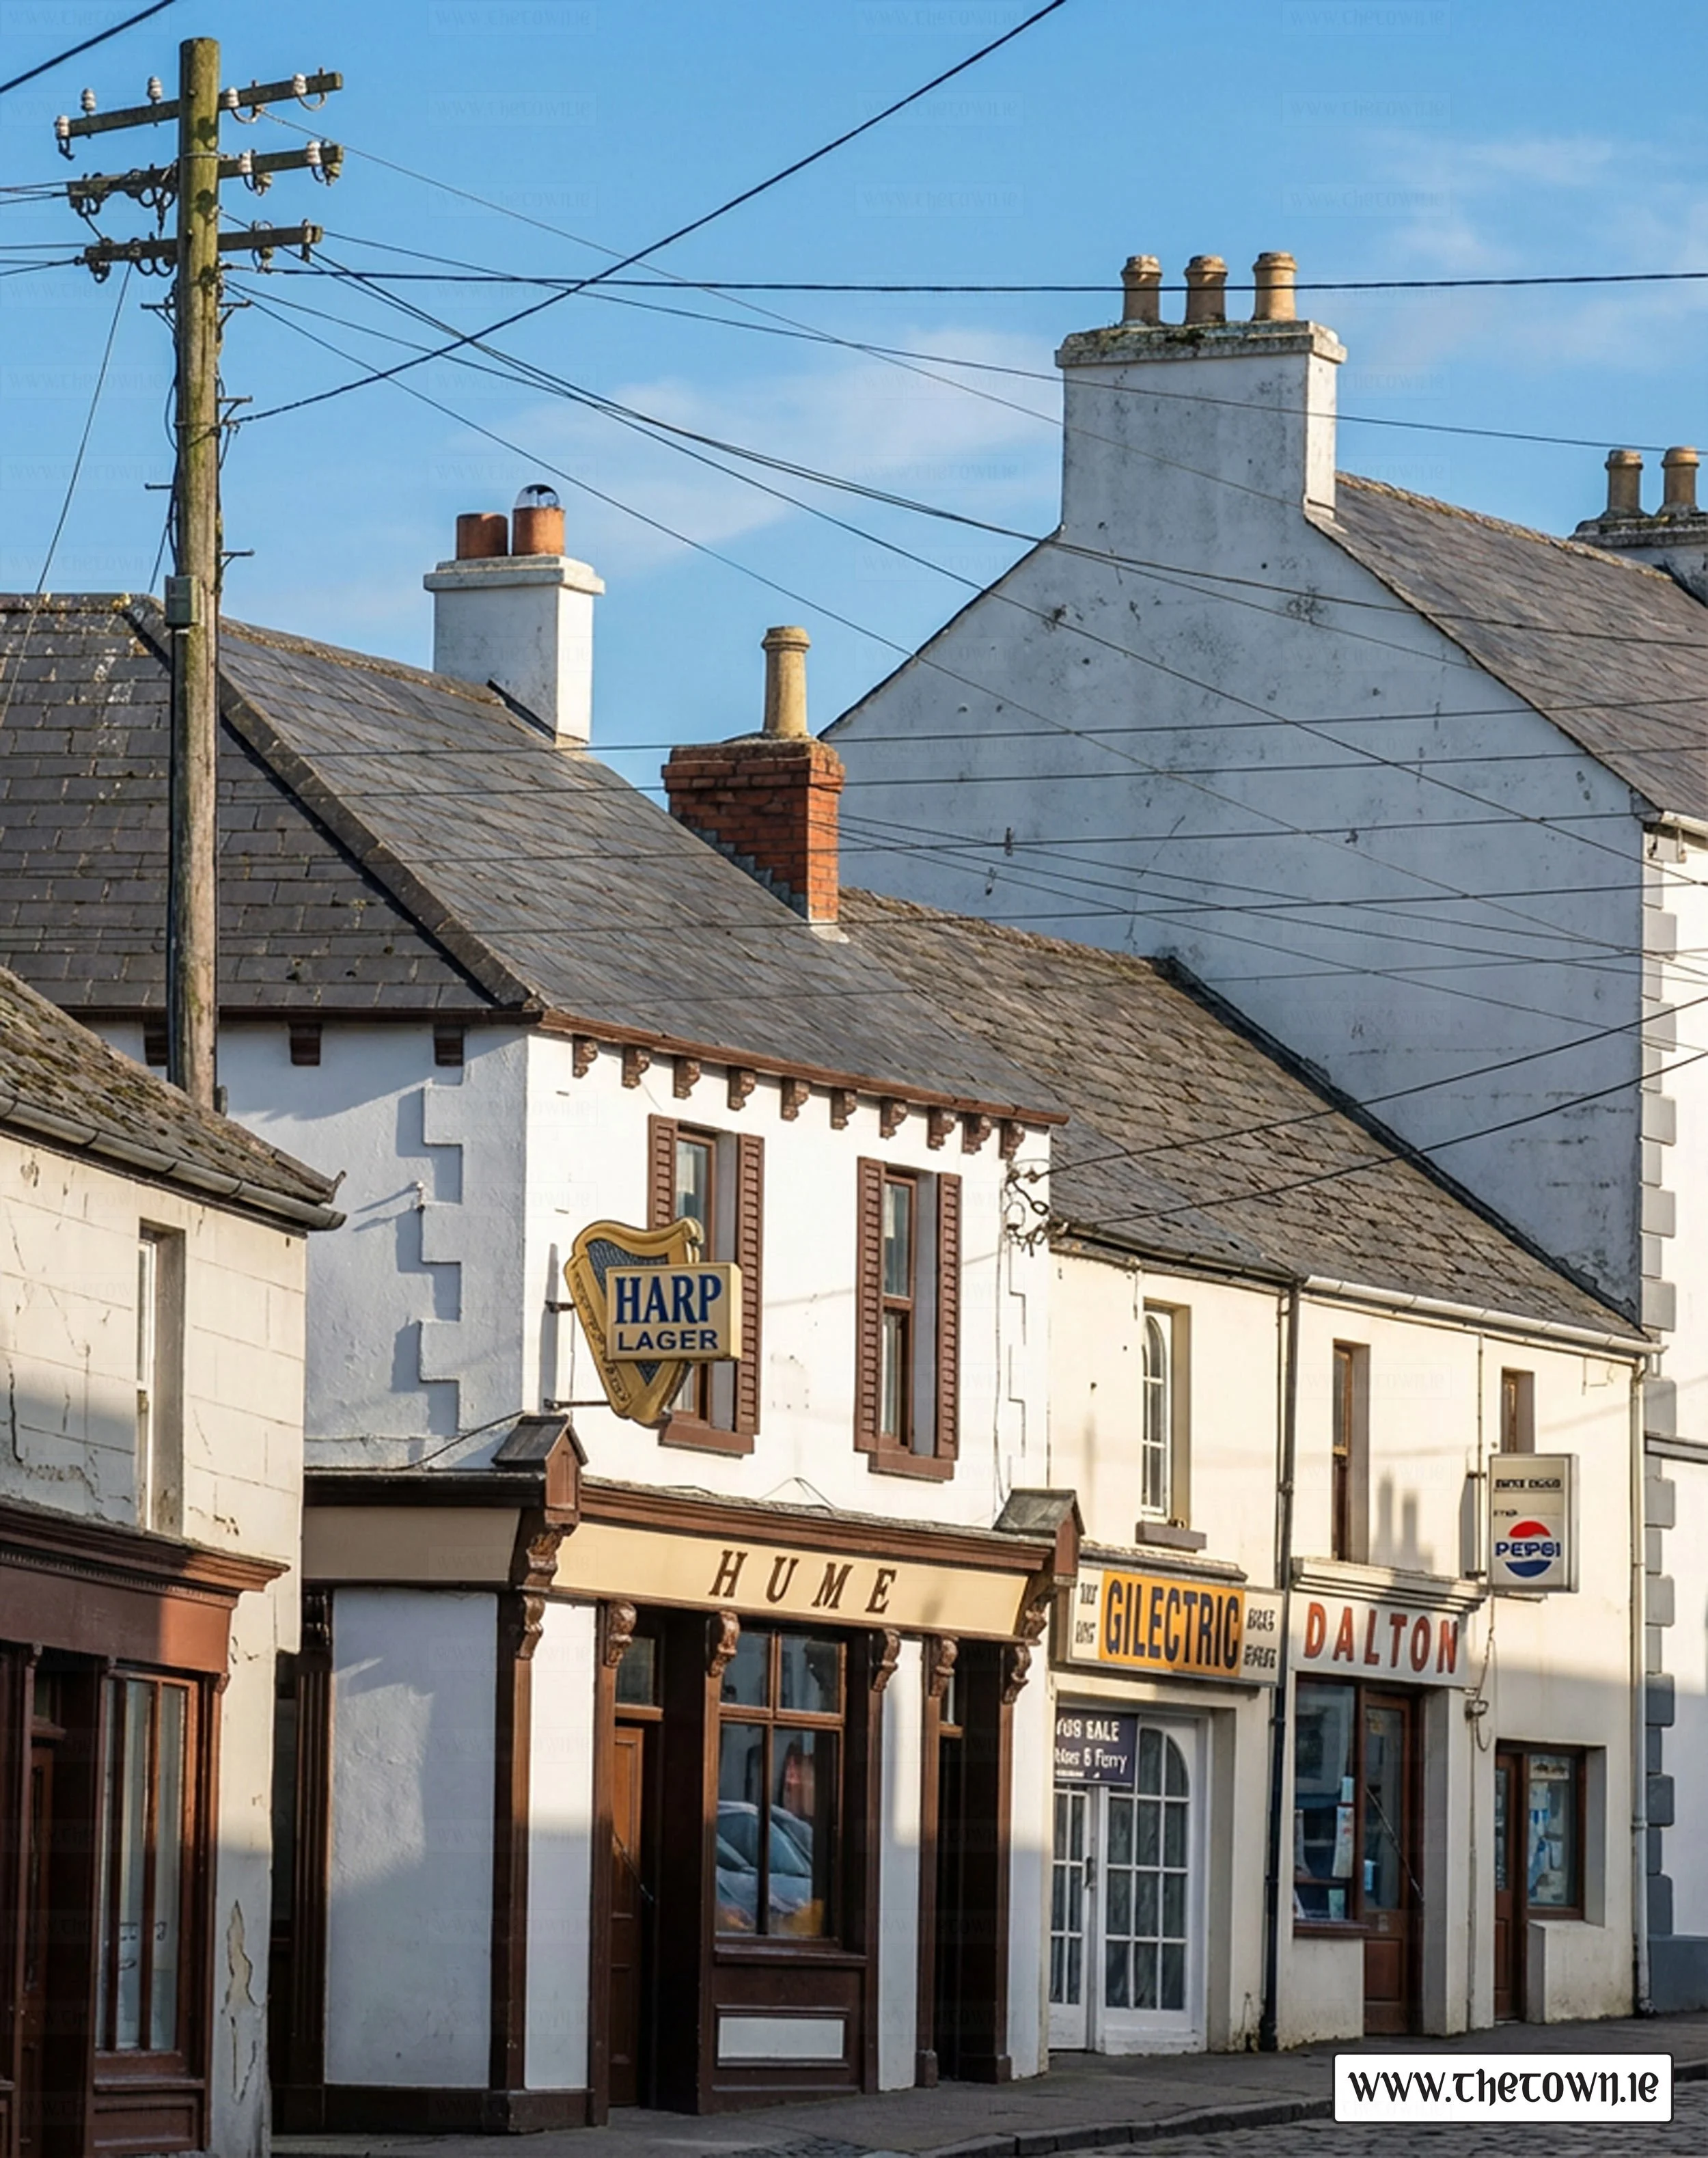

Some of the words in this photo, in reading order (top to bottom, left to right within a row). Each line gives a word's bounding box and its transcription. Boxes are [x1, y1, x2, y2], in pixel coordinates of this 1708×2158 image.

[615, 1274, 722, 1324] HARP
[618, 1329, 719, 1352] LAGER
[708, 1549, 897, 1614] HUME
[1105, 1579, 1240, 1670] GILECTRIC
[1304, 1600, 1459, 1674] DALTON
